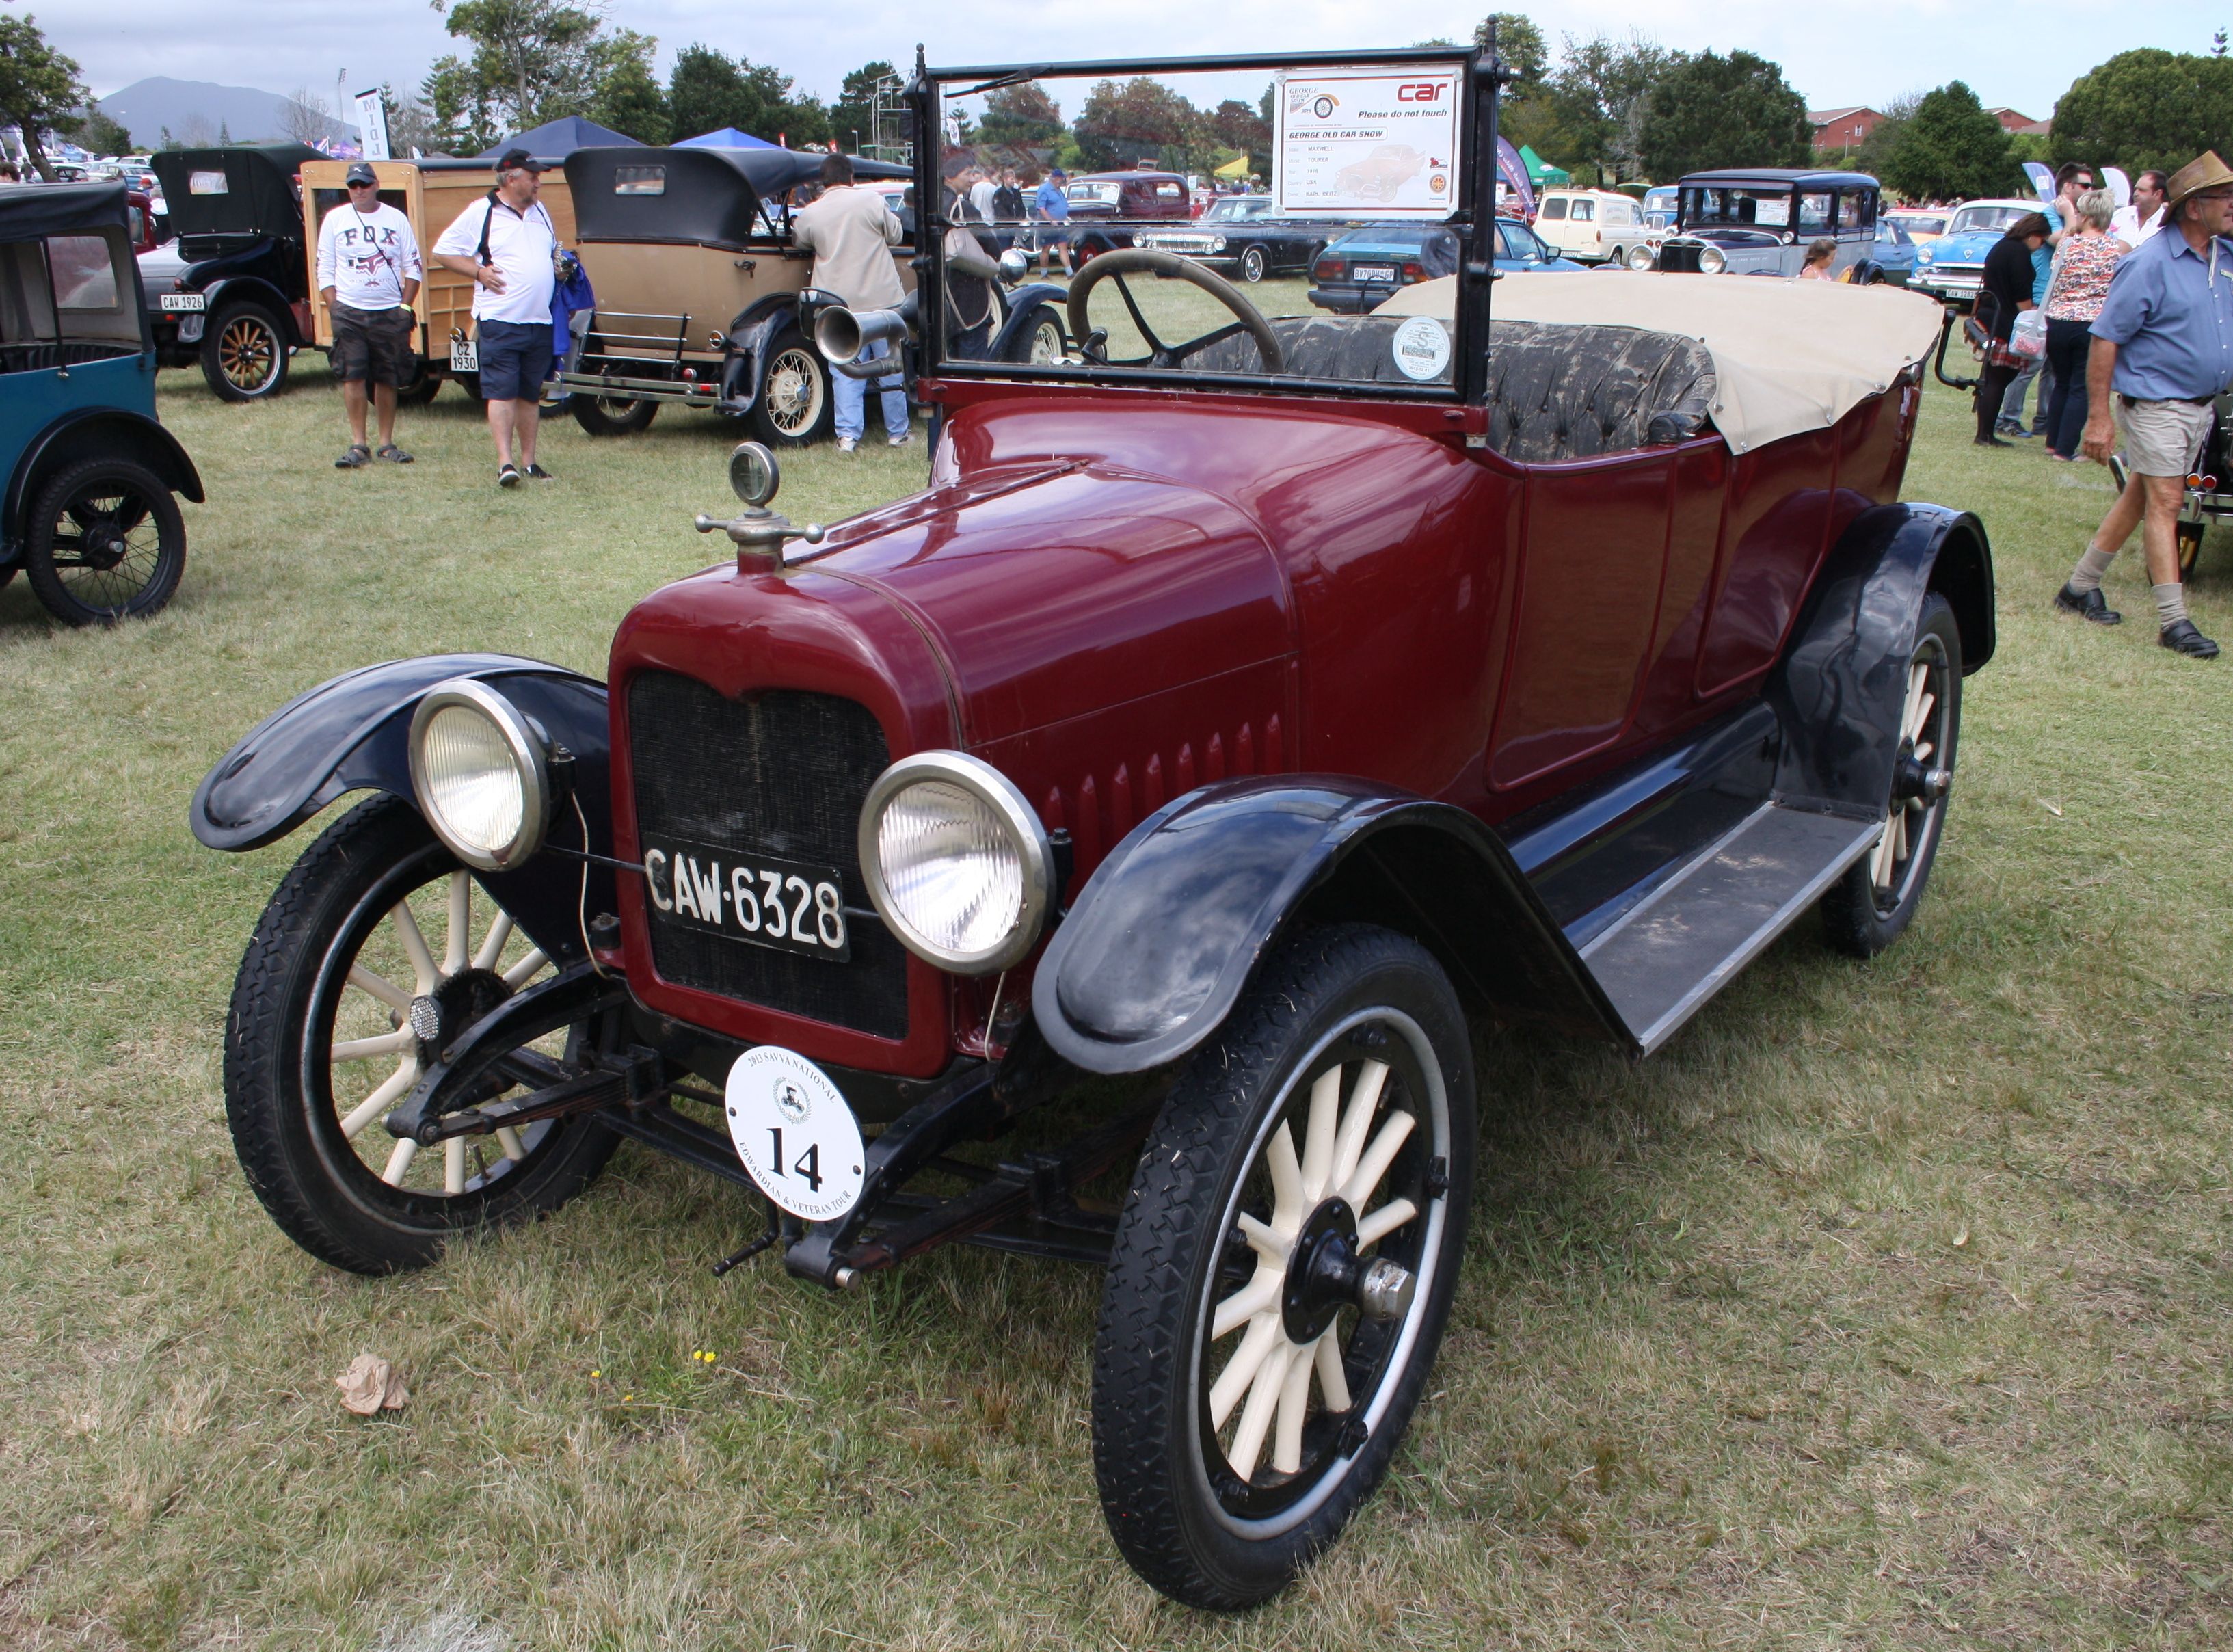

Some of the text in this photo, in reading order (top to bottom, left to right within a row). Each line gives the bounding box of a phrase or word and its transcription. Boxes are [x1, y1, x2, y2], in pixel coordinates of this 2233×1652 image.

[1398, 83, 1448, 102] car
[343, 226, 397, 246] FOX
[1385, 270, 1393, 279] GP
[163, 297, 202, 308] CAW 1926
[457, 343, 470, 356] CZ
[453, 357, 476, 369] 1930
[748, 1052, 835, 1104] 2013 SAVVA NATIONAL
[766, 1127, 823, 1193] 14
[739, 1141, 851, 1215] EDWARDIAN & VETERAN TOUR
